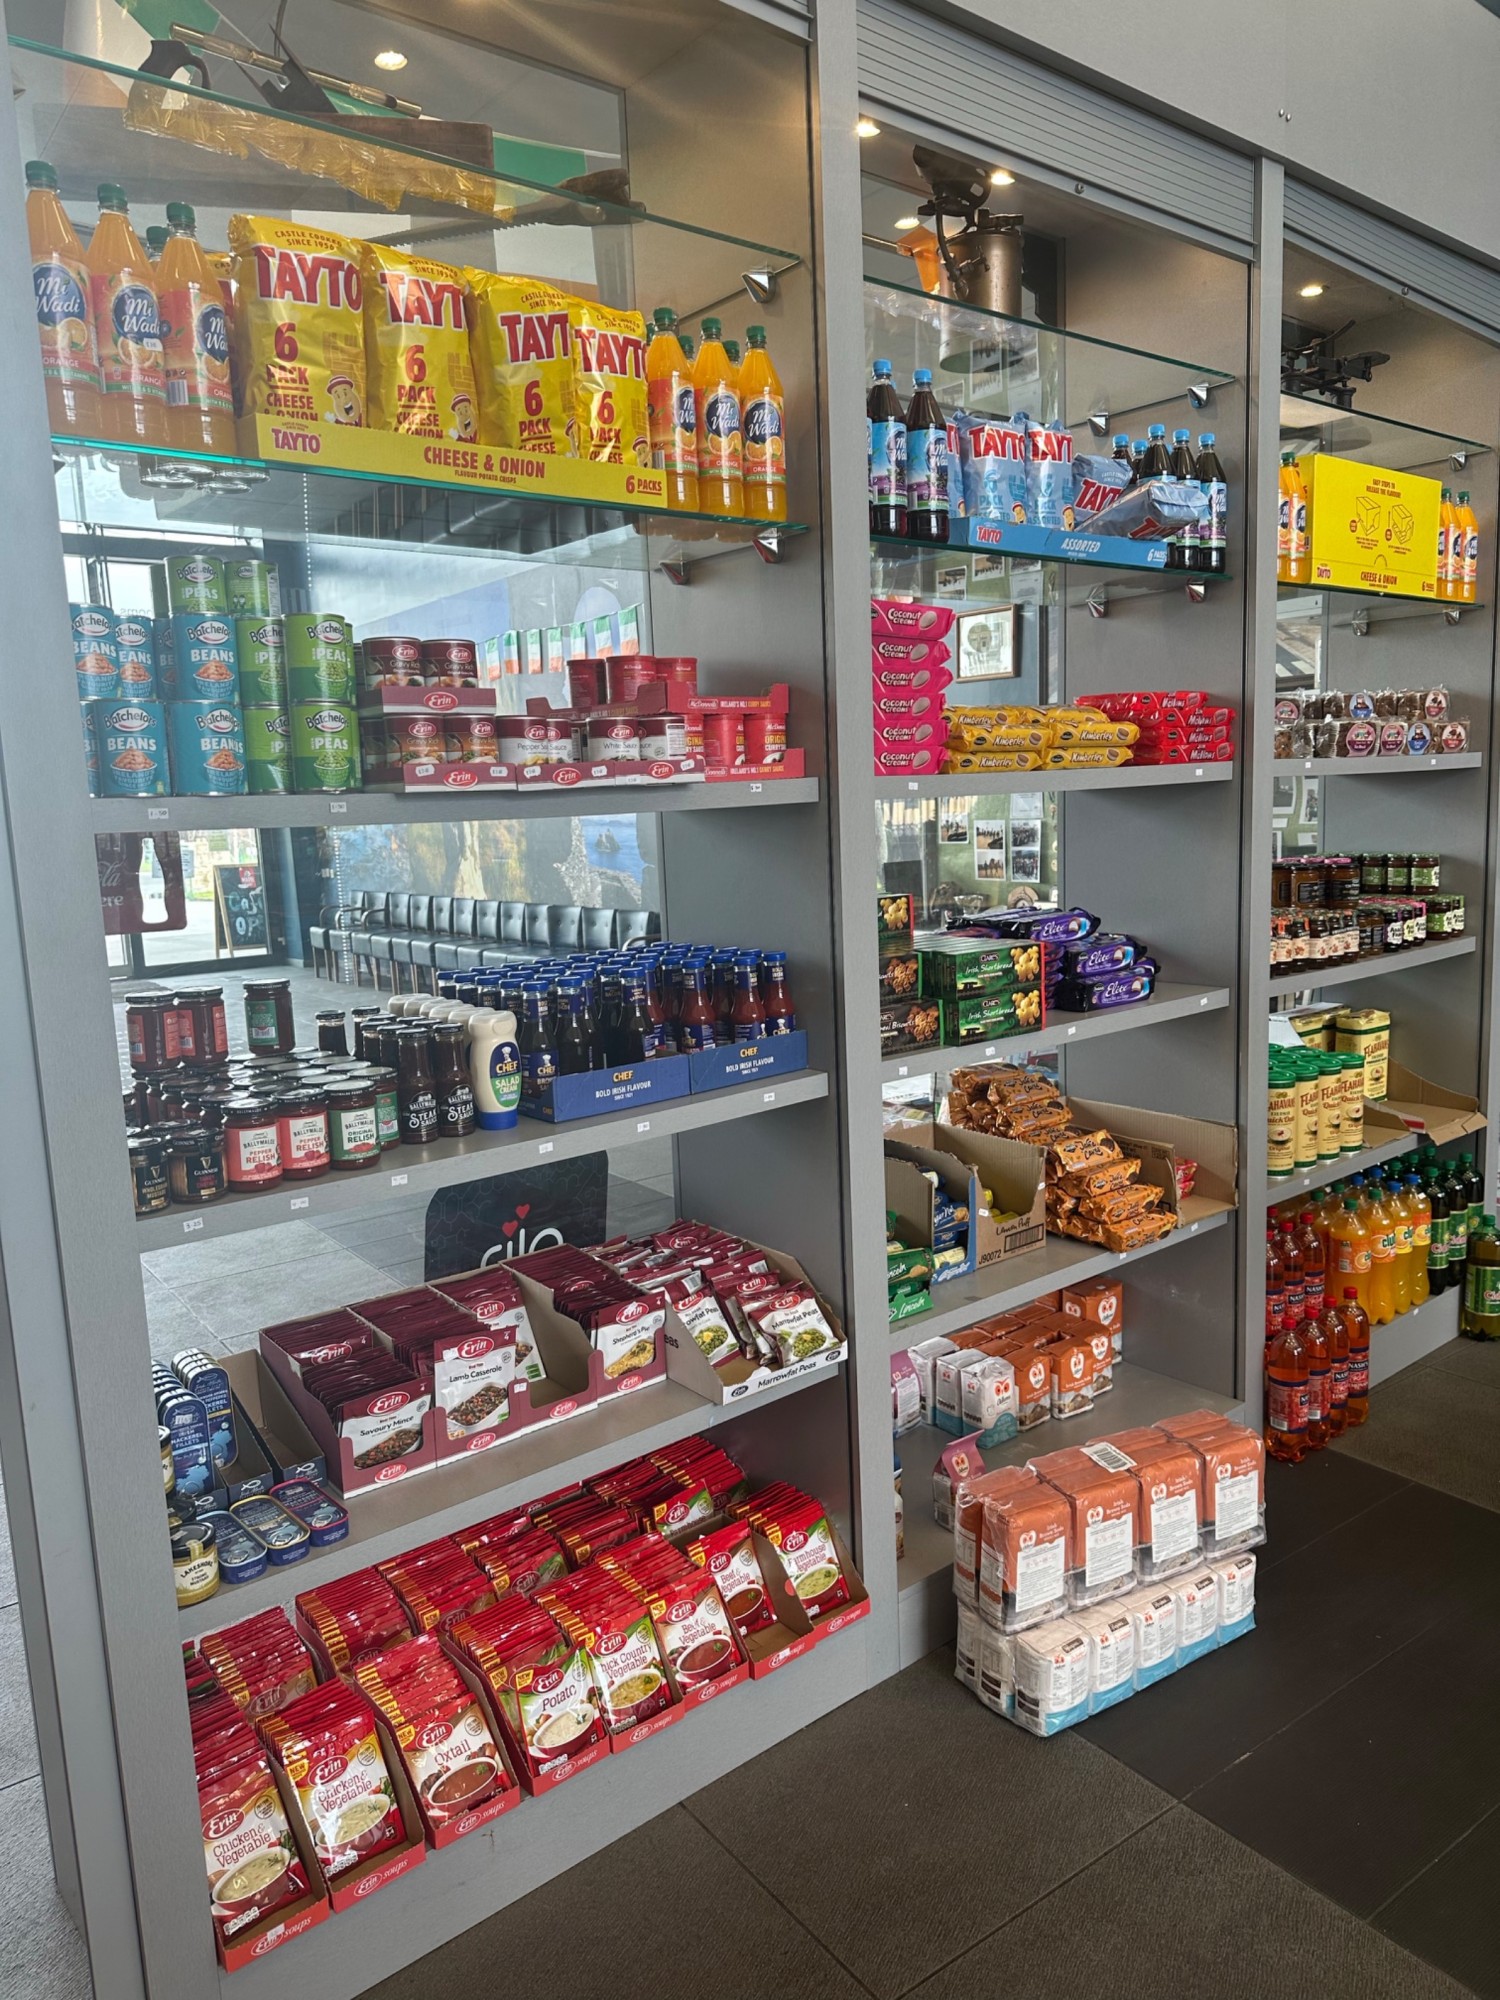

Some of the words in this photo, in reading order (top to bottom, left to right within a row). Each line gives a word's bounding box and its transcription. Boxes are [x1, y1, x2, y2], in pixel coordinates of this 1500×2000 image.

[275, 230, 307, 239] CASTLE
[287, 238, 313, 247] SINCE
[315, 240, 335, 251] 1956
[251, 244, 362, 312] TAYTO
[37, 277, 69, 296] Mi
[128, 298, 155, 316] Mi
[378, 271, 465, 331] TAYT
[122, 315, 161, 335] Wadi
[274, 322, 298, 362] 6
[500, 312, 569, 363] TAYT
[405, 344, 427, 383] 6
[266, 364, 309, 386] PACK
[266, 392, 314, 411] CHEESE
[397, 385, 436, 404] PACK
[524, 380, 544, 417] 6
[599, 391, 615, 425] 6
[396, 411, 439, 427] CHEESE
[519, 418, 551, 436] PACK
[748, 422, 780, 437] Wadi
[271, 427, 321, 454] TAYTO
[969, 425, 1025, 462] TAYTO
[424, 446, 478, 470] CHEESE
[484, 454, 494, 472] &
[499, 456, 546, 479] ONION
[455, 469, 477, 480] FLAVOUR
[478, 472, 498, 482] POTATO
[499, 475, 517, 484] CRISPS
[625, 475, 635, 493] 6
[637, 478, 662, 492] PACKS
[976, 526, 1002, 544] TAYTO
[1061, 537, 1101, 553] ASSORTED
[1147, 548, 1154, 562] 6
[1317, 566, 1331, 579] TAYTO
[1361, 571, 1378, 583] CHEESE
[1383, 575, 1397, 585] ONION
[186, 587, 218, 599] PEAS
[887, 607, 922, 621] Coconut
[316, 647, 346, 661] PEAS
[393, 644, 416, 660] Erin
[448, 648, 470, 662] Erin
[878, 641, 913, 653] Coconut
[190, 648, 234, 663] BEANS
[880, 671, 915, 683] Coconut
[425, 693, 453, 710] Erin
[880, 698, 914, 710] Coconut
[104, 709, 157, 729] Batchelors
[882, 726, 917, 738] Coconut
[1080, 731, 1114, 742] Kimberley
[107, 737, 157, 751] BEANS
[315, 737, 349, 751] PEAS
[517, 742, 539, 752] Pepper
[603, 741, 620, 749] White
[622, 741, 638, 750] Sauce
[993, 735, 1026, 746] Kimberley
[880, 752, 915, 764] Coconut
[980, 757, 1012, 768] Kimberley
[1071, 752, 1104, 763] Kimberley
[450, 773, 472, 787] Erin
[1043, 921, 1065, 936] Elite
[1088, 950, 1110, 966] Elite
[966, 965, 979, 975] Irish
[980, 962, 1013, 972] Shortbread
[1105, 981, 1128, 997] Elite
[968, 1011, 982, 1020] Irish
[982, 1007, 1014, 1018] Shortbread
[740, 1046, 759, 1058] CHEF
[495, 1060, 518, 1074] CHEF
[537, 1065, 556, 1075] CHEF
[726, 1065, 738, 1073] BOLD
[740, 1061, 752, 1070] IRISH
[753, 1056, 774, 1066] FLAVOUR
[495, 1077, 520, 1089] SALAD
[613, 1070, 634, 1082] CHEF
[500, 1084, 518, 1094] CREAM
[595, 1089, 611, 1098] BOLD
[612, 1086, 626, 1095] IRISH
[627, 1080, 651, 1092] FLAVOUR
[409, 1109, 438, 1129] STEAK
[459, 1109, 475, 1120] SAUCE
[1302, 1108, 1318, 1116] Quic
[420, 1117, 438, 1127] SAUCE
[299, 1136, 321, 1144] PEPPER
[347, 1128, 373, 1137] ORIGINAL
[347, 1132, 375, 1144] RELISH
[249, 1148, 272, 1156] PEPPER
[296, 1141, 324, 1152] RELISH
[246, 1153, 276, 1164] RELISH
[996, 1224, 1018, 1236] Lemon
[1018, 1216, 1031, 1228] Puff
[979, 1249, 1002, 1265] J90072
[476, 1303, 498, 1319] Erin
[705, 1306, 719, 1316] Peas
[772, 1314, 802, 1330] Marrowfat
[802, 1308, 819, 1320] Peas
[461, 1340, 487, 1358] Erin
[1349, 1360, 1369, 1369] NASH'S
[449, 1371, 470, 1383] Lamb
[470, 1365, 503, 1378] Casserole
[757, 1366, 798, 1388] Marrowfat
[798, 1361, 817, 1374] Peas
[375, 1394, 403, 1413] Erin
[360, 1421, 392, 1437] Savoury
[392, 1414, 414, 1428] Mince
[171, 1433, 204, 1444] MACKEREL
[710, 1555, 728, 1570] Erin
[788, 1544, 827, 1565] Farmhouse
[180, 1560, 215, 1578] LAKESHORE
[720, 1571, 735, 1584] Beef
[670, 1604, 693, 1622] Erin
[679, 1623, 717, 1645] Vegetable
[600, 1634, 624, 1653] Erin
[619, 1643, 652, 1663] Country
[606, 1655, 648, 1678] Vegetable
[517, 1673, 532, 1682] NEW
[536, 1672, 560, 1690] Erin
[542, 1685, 577, 1711] Potato
[398, 1730, 413, 1740] NEW
[421, 1724, 448, 1745] Erin
[434, 1740, 471, 1767] Oxtail
[576, 1750, 598, 1767] soups
[313, 1759, 343, 1784] Erin
[318, 1777, 361, 1803] Chicken
[320, 1779, 373, 1813] Vegetable
[482, 1801, 505, 1820] soups
[209, 1811, 238, 1837] Erin
[213, 1828, 257, 1858] Chicken
[217, 1832, 272, 1868] Vegetable
[382, 1858, 408, 1880] soups
[283, 1915, 312, 1939] soups
